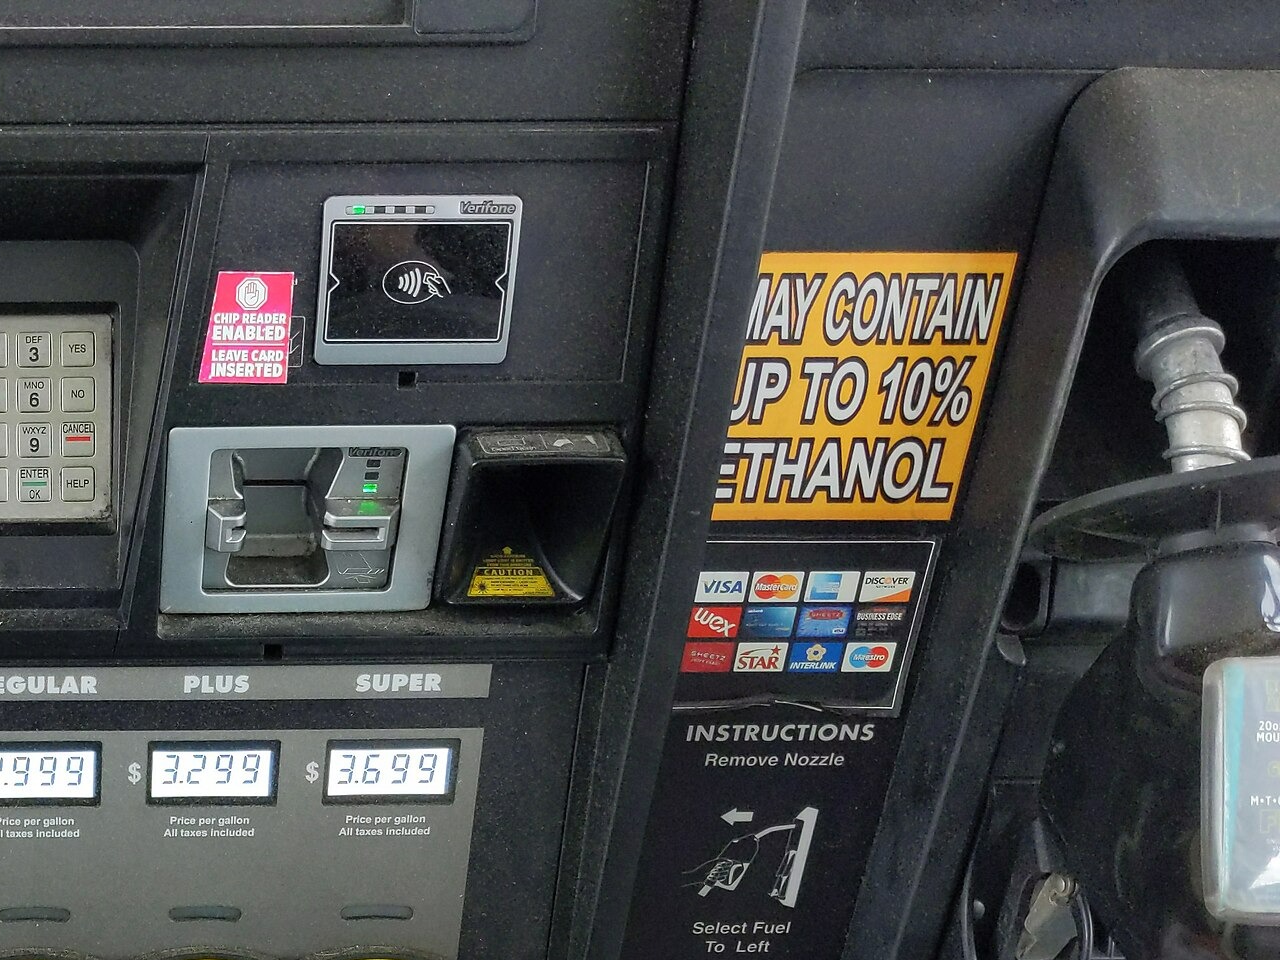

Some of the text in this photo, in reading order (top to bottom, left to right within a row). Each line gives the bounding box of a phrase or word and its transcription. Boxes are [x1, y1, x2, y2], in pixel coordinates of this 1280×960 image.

[460, 201, 516, 214] Verifone
[744, 271, 1004, 346] MAY CONTAIN
[214, 313, 287, 324] CHIP READER
[212, 325, 286, 341] ENABLED
[25, 336, 43, 344] DEF
[29, 347, 40, 362] 3
[69, 345, 86, 353] YES
[211, 350, 284, 362] LEAVE CARD
[210, 363, 283, 378] INSERTED
[24, 381, 45, 389] MNO
[800, 356, 869, 426] TO
[877, 356, 977, 427] 10%
[29, 393, 40, 407] 6
[71, 390, 85, 398] NO
[22, 427, 46, 435] WXYZ
[62, 424, 94, 434] CANCEL
[29, 438, 40, 453] 9
[348, 447, 401, 457] Verifone
[20, 469, 49, 479] ENTER
[715, 436, 954, 504] ETHANOL
[66, 480, 89, 488] HELP
[29, 490, 41, 499] OK
[704, 579, 743, 594] VISA
[755, 583, 798, 591] MasterCard
[865, 577, 909, 585] DISCOVER
[856, 612, 902, 621] BUSINESS EDGE
[737, 656, 779, 669] STAR
[853, 653, 885, 661] Maestro
[789, 661, 837, 669] INTERLINK
[183, 674, 250, 694] PLUS
[356, 673, 442, 692] SUPER
[1259, 720, 1280, 731] 20o
[686, 723, 876, 742] INSTRUCTIONS
[704, 753, 845, 767] Remove Nozzle
[162, 754, 261, 785] 3.299
[337, 753, 438, 784] 3.699
[23, 818, 39, 828] per
[42, 816, 75, 828] gallon
[5, 829, 33, 838] taxes
[36, 828, 80, 838] included
[692, 921, 791, 935] Select Fuel
[705, 940, 770, 953] To Left
